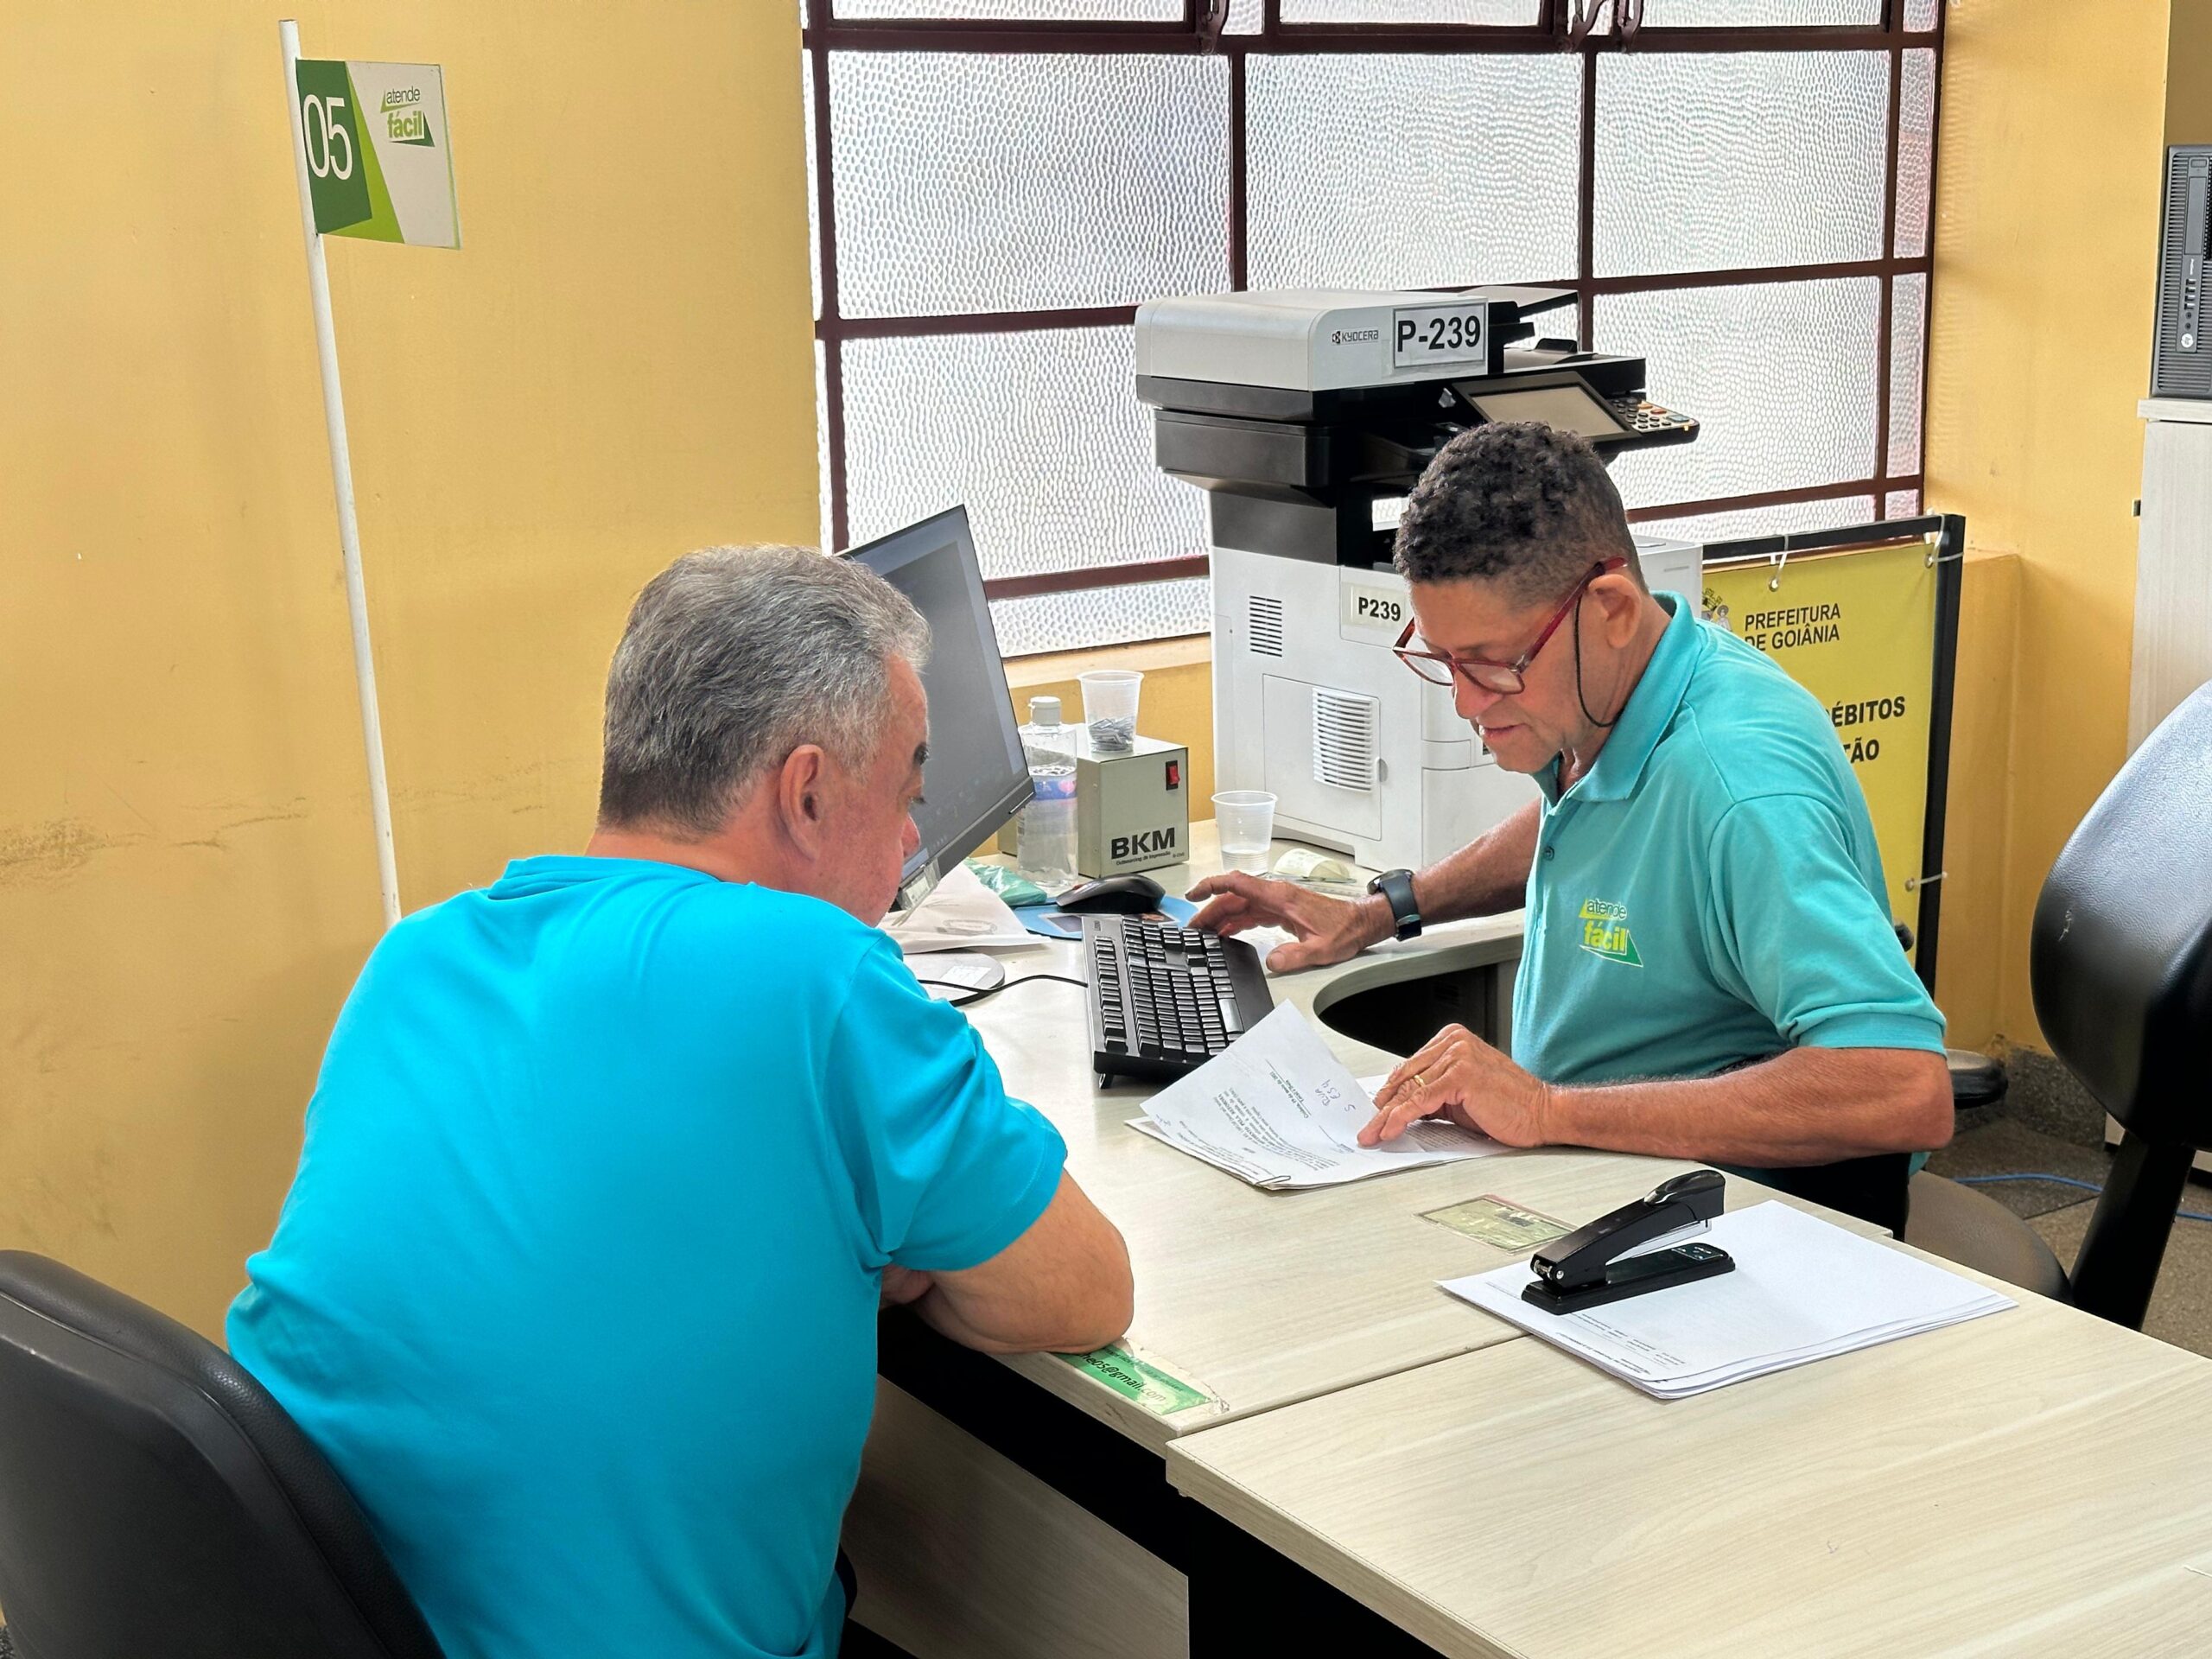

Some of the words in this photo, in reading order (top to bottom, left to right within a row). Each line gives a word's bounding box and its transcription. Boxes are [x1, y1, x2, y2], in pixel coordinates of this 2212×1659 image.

[386, 86, 420, 104] atende
[303, 93, 353, 180] 05
[387, 111, 423, 138] fácil
[1341, 329, 1379, 343] KYOCERA
[1397, 315, 1481, 352] P-239
[1358, 596, 1401, 621] P239
[1745, 603, 1840, 632] PREFEITURA
[1771, 623, 1840, 650] GOIÂNIA
[1826, 696, 1905, 728] ÉBITOS
[1111, 827, 1175, 860] BKM
[1586, 899, 1627, 919] atende
[1584, 920, 1627, 951] fácil
